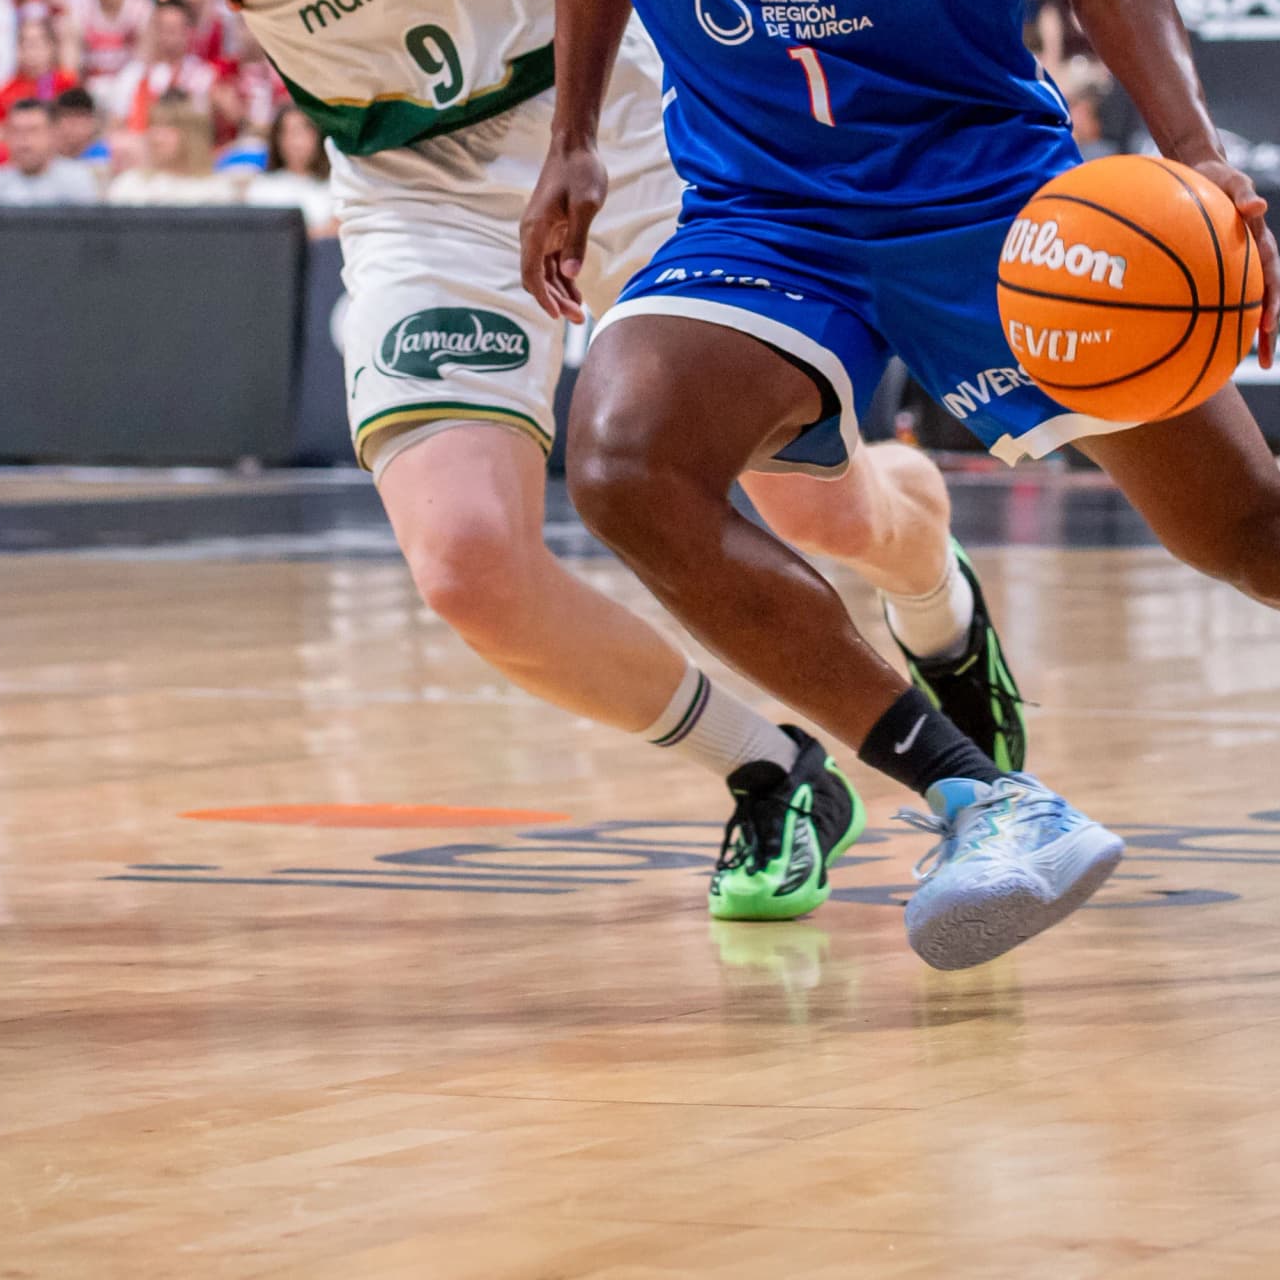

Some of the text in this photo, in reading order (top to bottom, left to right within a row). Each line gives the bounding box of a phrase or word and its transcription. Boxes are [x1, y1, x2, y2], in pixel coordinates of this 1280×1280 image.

[761, 3, 837, 23] REGIÓN
[765, 15, 875, 40] DE MURCIA
[404, 22, 465, 110] 9
[786, 45, 836, 128] 1
[1001, 217, 1127, 290] Wilson
[387, 312, 526, 369] famadesa
